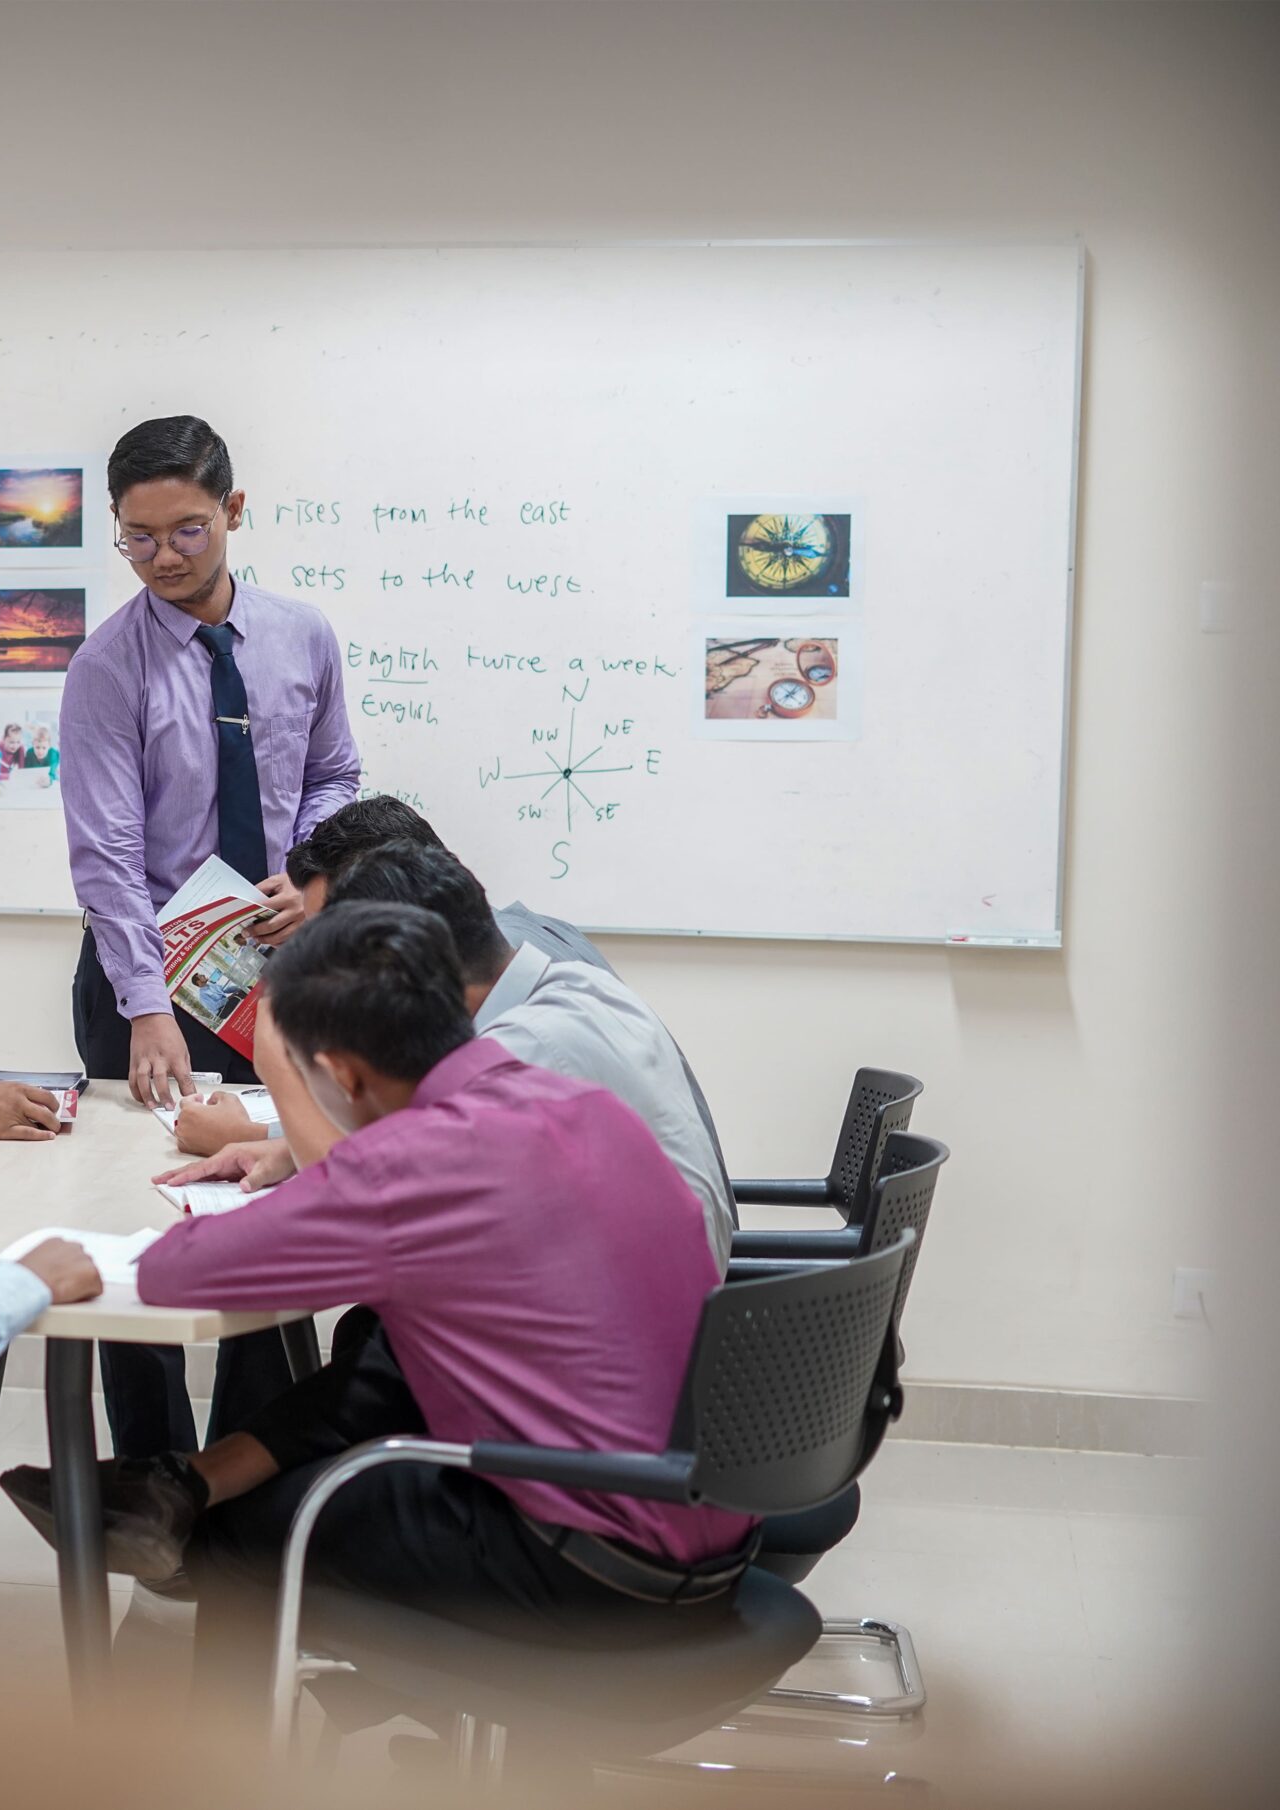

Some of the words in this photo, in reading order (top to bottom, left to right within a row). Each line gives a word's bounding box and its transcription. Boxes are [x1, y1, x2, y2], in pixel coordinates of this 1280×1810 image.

[275, 499, 341, 526] rises
[447, 497, 489, 527] the
[519, 501, 571, 526] east
[291, 564, 346, 592] sets
[379, 568, 404, 592] to
[421, 562, 475, 590] the
[348, 641, 439, 679] English
[466, 645, 548, 674] twice
[568, 657, 585, 672] a
[562, 677, 591, 704] N
[361, 693, 439, 726] English
[531, 727, 559, 745] NW
[603, 718, 635, 739] NE
[478, 756, 501, 789] W
[645, 749, 662, 776] E
[549, 840, 571, 880] S
